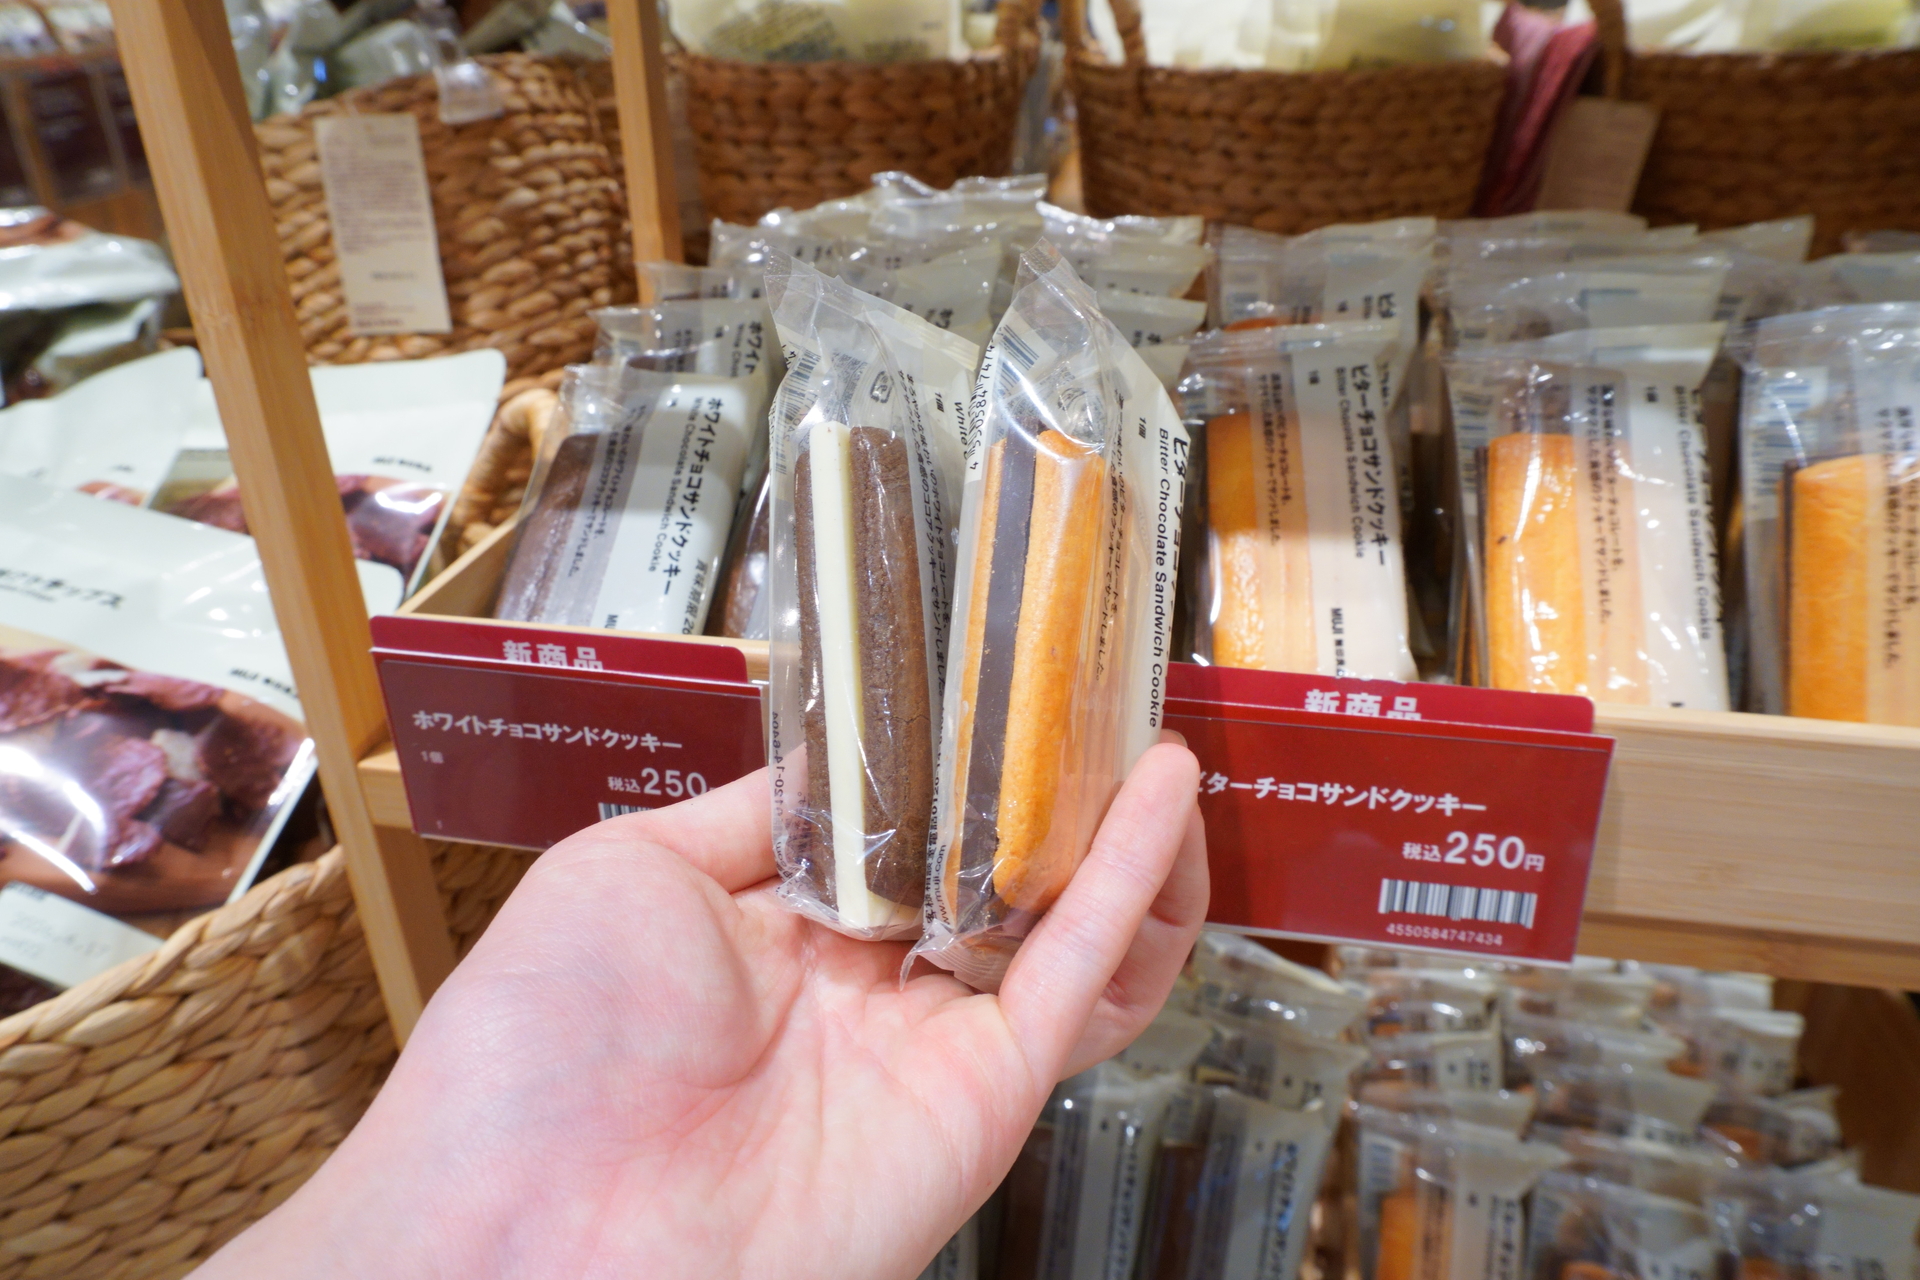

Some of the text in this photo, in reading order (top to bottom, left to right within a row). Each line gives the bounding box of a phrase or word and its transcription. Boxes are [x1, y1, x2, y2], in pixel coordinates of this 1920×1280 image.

[674, 423, 697, 476] Chocolate
[1351, 364, 1390, 566] ビターチョコサンドクッキー
[659, 477, 682, 531] Sandwich
[663, 397, 723, 595] ホワイトチョコサンドクッキー
[648, 532, 667, 572] Cookie
[1351, 516, 1364, 558] Cookie
[1150, 427, 1171, 728] Bitter Chocolate Sandwich Cookie
[1689, 508, 1705, 581] Sandwich
[1697, 586, 1711, 640] Cookie
[1331, 608, 1344, 634] MUJI
[502, 640, 604, 670] 新商品
[1304, 689, 1422, 720] 新商品
[412, 711, 683, 752] ホワイトチョコサンドクッキー
[420, 751, 444, 764] 1個
[607, 767, 718, 798] 税込250
[1196, 772, 1487, 816] ターチョコサンドクッキー
[933, 844, 951, 926] ww.muji.com
[1386, 923, 1504, 946] 4550584747434
